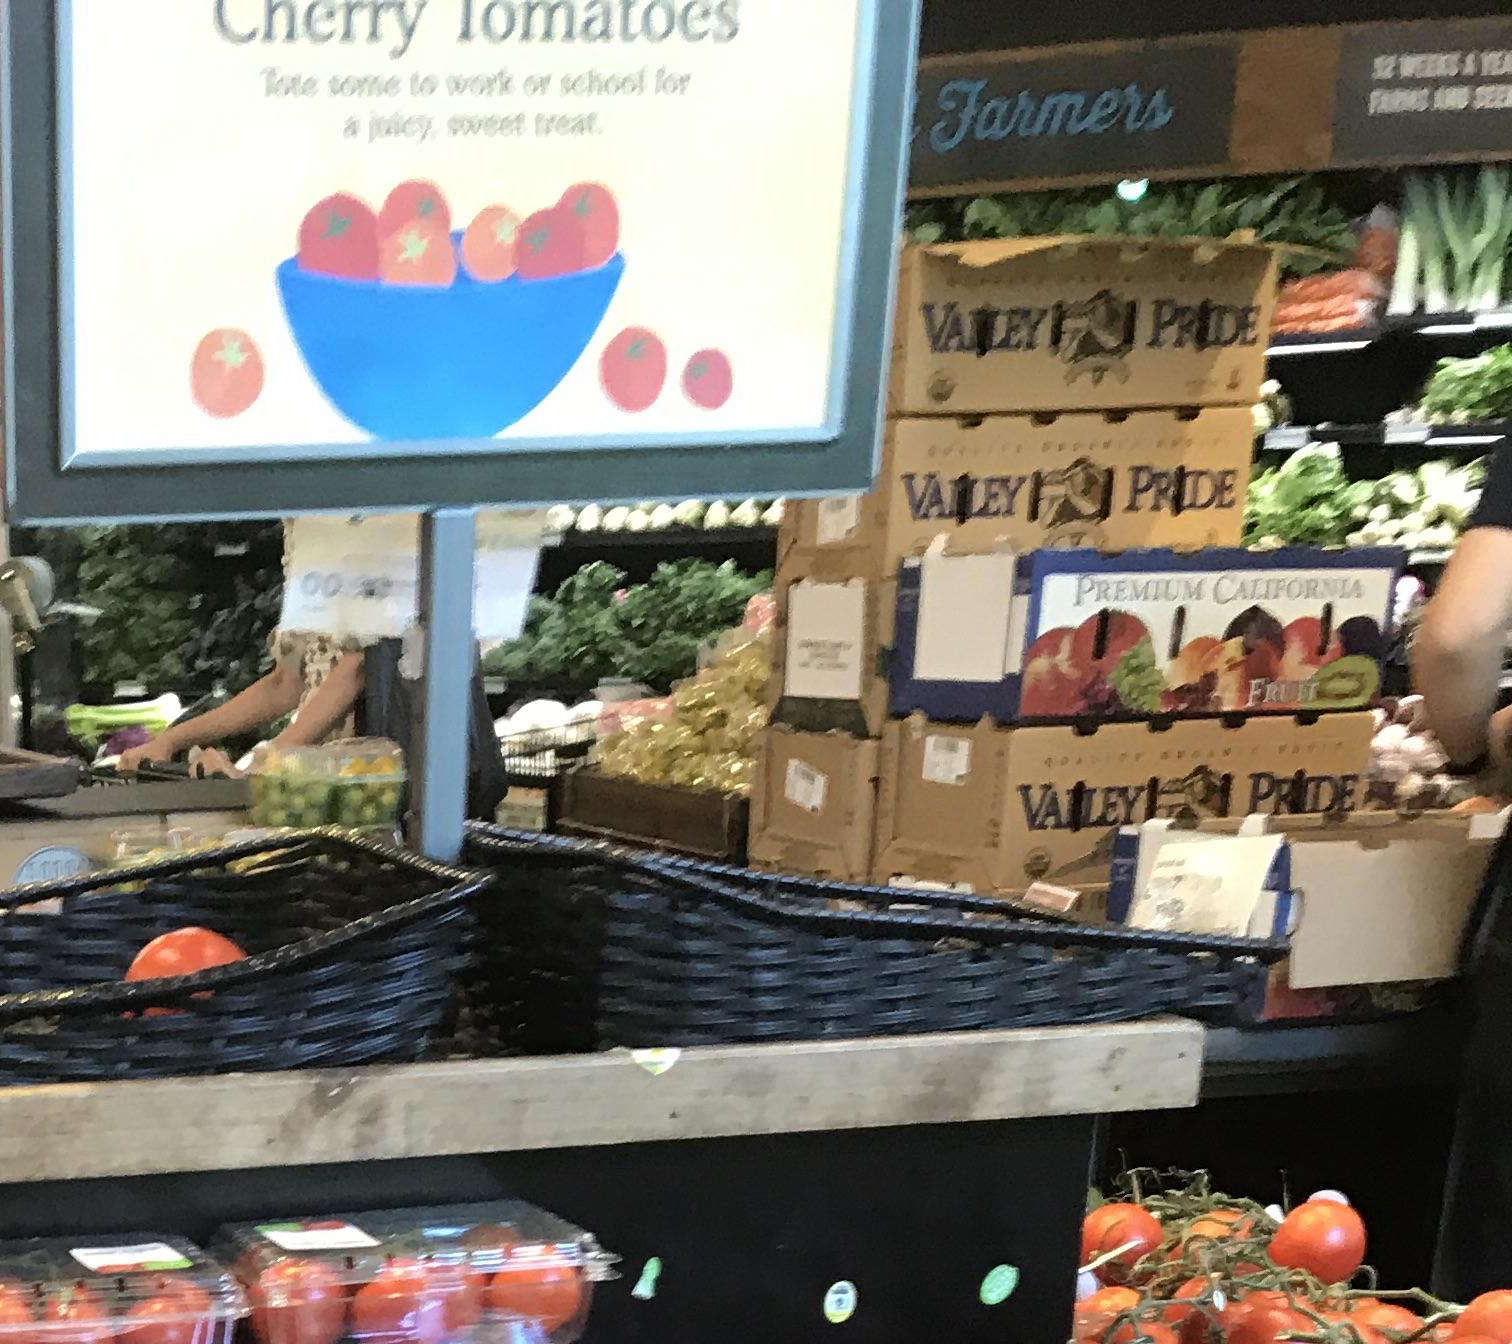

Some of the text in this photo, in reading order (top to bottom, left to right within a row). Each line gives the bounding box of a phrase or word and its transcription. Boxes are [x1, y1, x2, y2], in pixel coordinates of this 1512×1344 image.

[213, 0, 742, 59] Cherry Tomatoes
[258, 66, 693, 98] Tote some to work or school for
[342, 111, 604, 144] a juicy, sweet treat.
[929, 79, 1176, 154] Farmers
[920, 298, 1263, 353] VALLEY PRIDE
[901, 465, 1240, 521] VALLEY PRIDE
[1074, 571, 1365, 607] PREMIUM CALIFORNIA
[1246, 677, 1320, 707] FRUIT
[1017, 771, 1360, 831] VALLEY PRIDE
